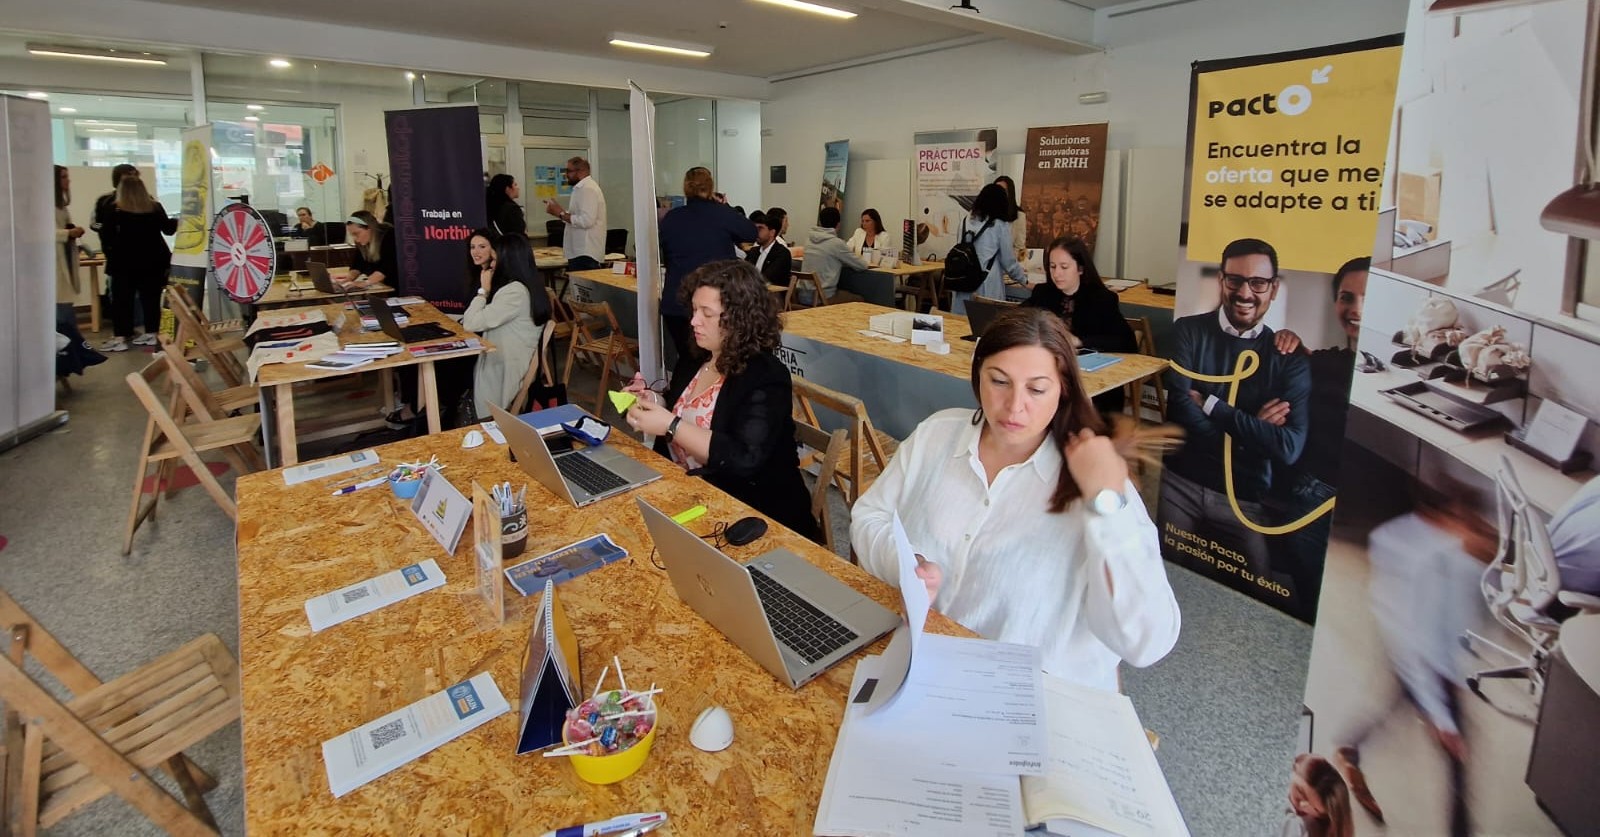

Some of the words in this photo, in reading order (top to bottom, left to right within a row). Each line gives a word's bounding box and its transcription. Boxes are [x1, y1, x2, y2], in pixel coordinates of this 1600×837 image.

[1040, 135, 1091, 146] Soluciones
[1207, 140, 1327, 159] Encuentra
[1336, 134, 1361, 155] la
[919, 147, 980, 160] PRÁCTICAS
[1039, 146, 1090, 157] innovadoras
[919, 161, 948, 172] FUAC
[1038, 160, 1050, 169] en
[1053, 157, 1089, 169] RRHH
[1205, 165, 1273, 184] oferta
[1280, 168, 1329, 187] que
[1204, 193, 1227, 208] se
[1234, 191, 1323, 213] adapte
[1331, 195, 1348, 210] a
[421, 209, 451, 220] Trabaja
[451, 210, 462, 218] en
[1165, 522, 1208, 547] Nuestro
[1210, 541, 1248, 566] Pacto,
[1164, 534, 1175, 547] la
[1177, 542, 1215, 565] pasión
[1217, 559, 1239, 574] por
[1241, 569, 1254, 583] tu
[1256, 576, 1291, 598] éxito
